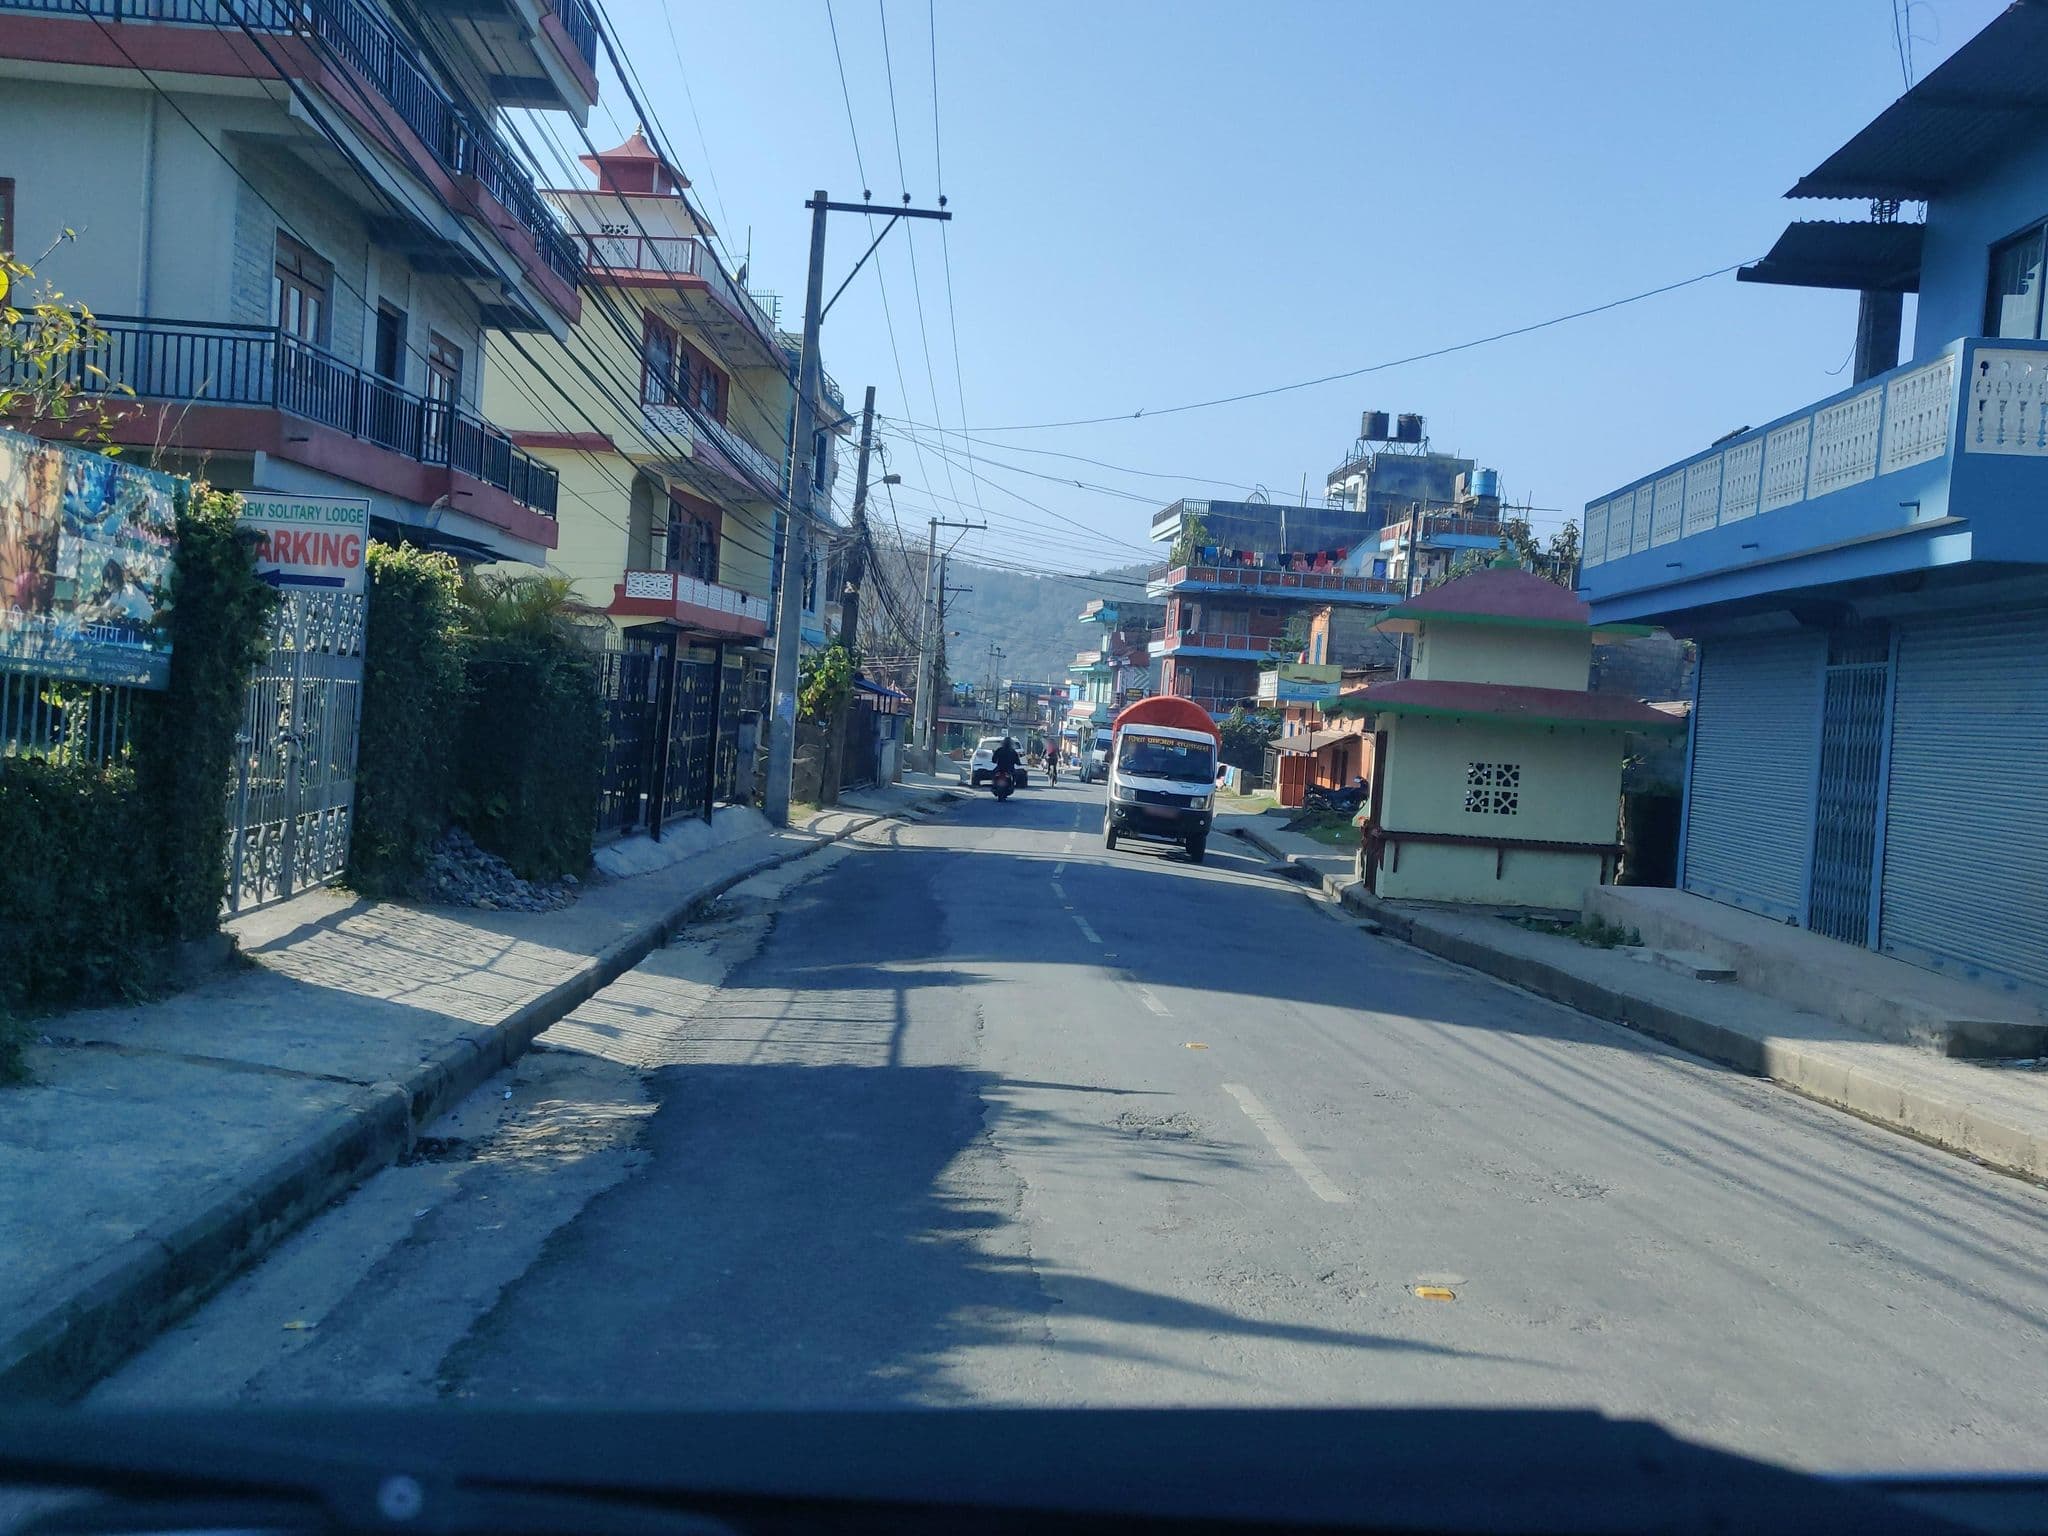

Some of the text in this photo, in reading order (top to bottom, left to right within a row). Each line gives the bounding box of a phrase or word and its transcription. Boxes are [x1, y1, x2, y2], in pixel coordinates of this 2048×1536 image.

[268, 503, 322, 520] SOLITARY
[326, 507, 364, 523] LODGE
[255, 530, 360, 568] ARKING
